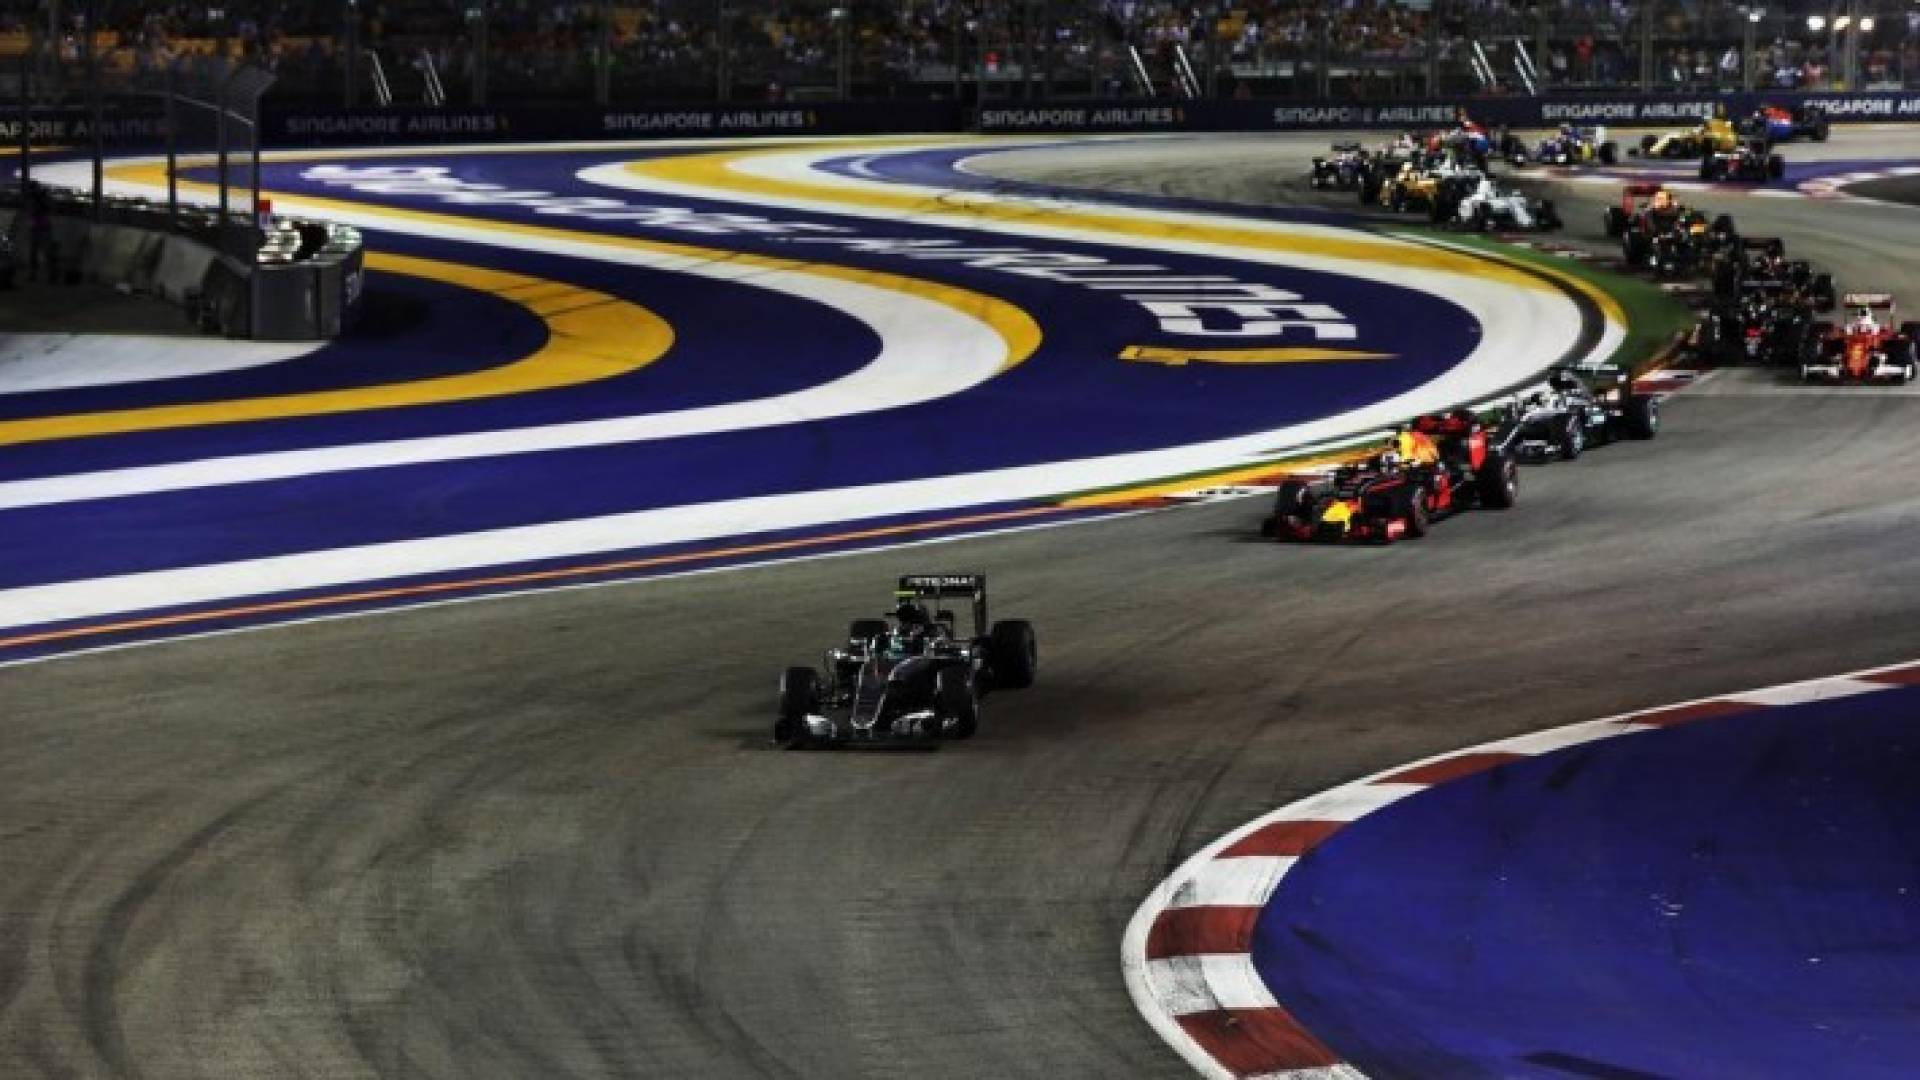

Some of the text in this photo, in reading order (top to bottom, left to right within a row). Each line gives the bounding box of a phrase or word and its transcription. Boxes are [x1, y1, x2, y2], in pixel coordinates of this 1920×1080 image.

[982, 108, 1172, 125] SINGAPORE AIRLINES
[1377, 107, 1455, 121] AIRLINES
[1541, 102, 1712, 119] SINGAPORE AIRLINES
[286, 114, 494, 132] SINGAPORE AIRLINES
[604, 111, 802, 129] SINGAPORE AIRLINES
